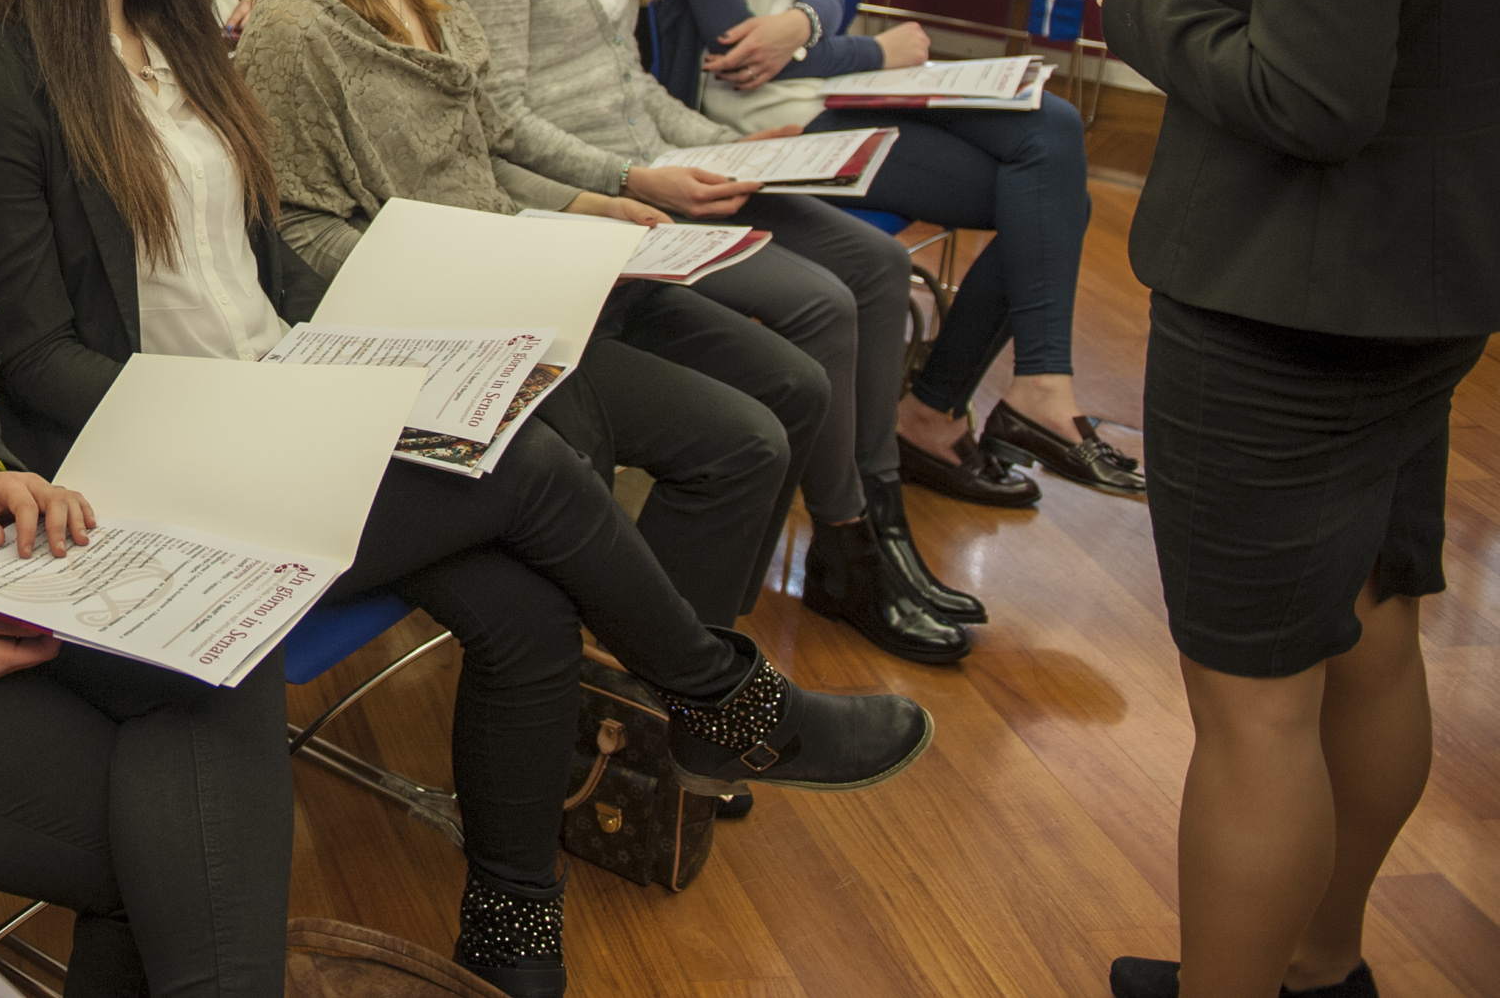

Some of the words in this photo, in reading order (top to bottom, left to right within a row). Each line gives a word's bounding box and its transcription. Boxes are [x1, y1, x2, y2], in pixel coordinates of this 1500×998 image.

[521, 337, 542, 351] Un
[500, 352, 528, 378] giorno
[491, 380, 510, 389] in
[468, 392, 501, 428] Senato
[289, 571, 316, 586] Un
[254, 585, 294, 617] giorno
[239, 617, 263, 628] in
[199, 629, 248, 665] Senato
